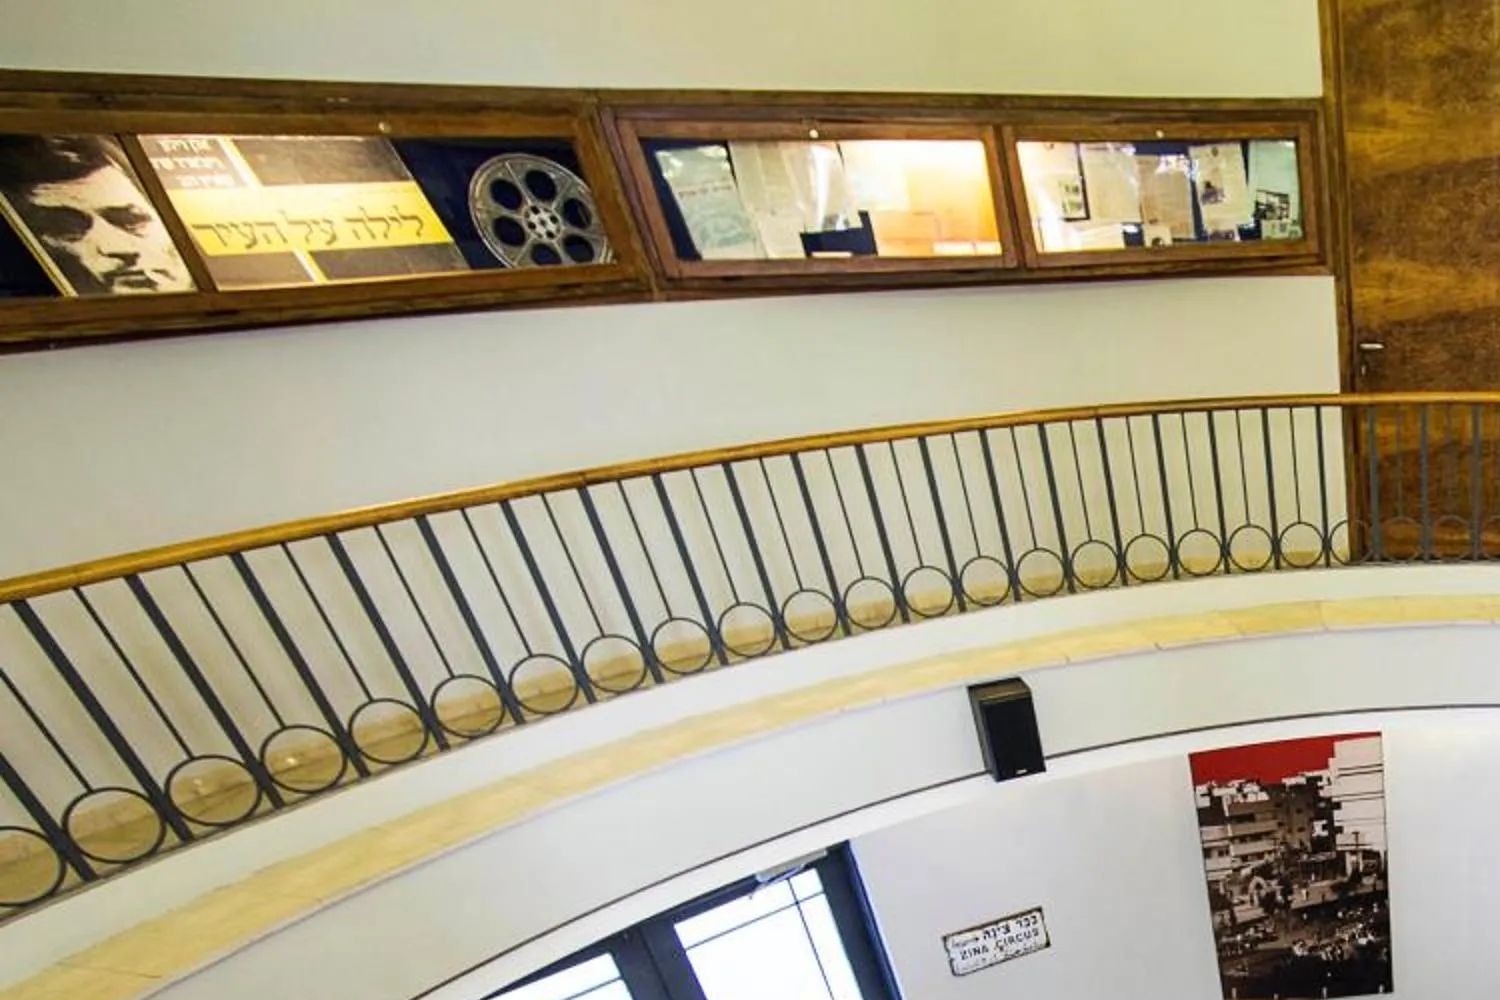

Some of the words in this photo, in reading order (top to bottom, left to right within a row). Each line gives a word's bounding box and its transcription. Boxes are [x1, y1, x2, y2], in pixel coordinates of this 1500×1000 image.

[191, 220, 289, 250] העיר
[278, 208, 338, 246] על
[344, 204, 424, 241] לילה
[960, 945, 989, 960] ZINA
[995, 929, 1039, 947] CIRCUS
